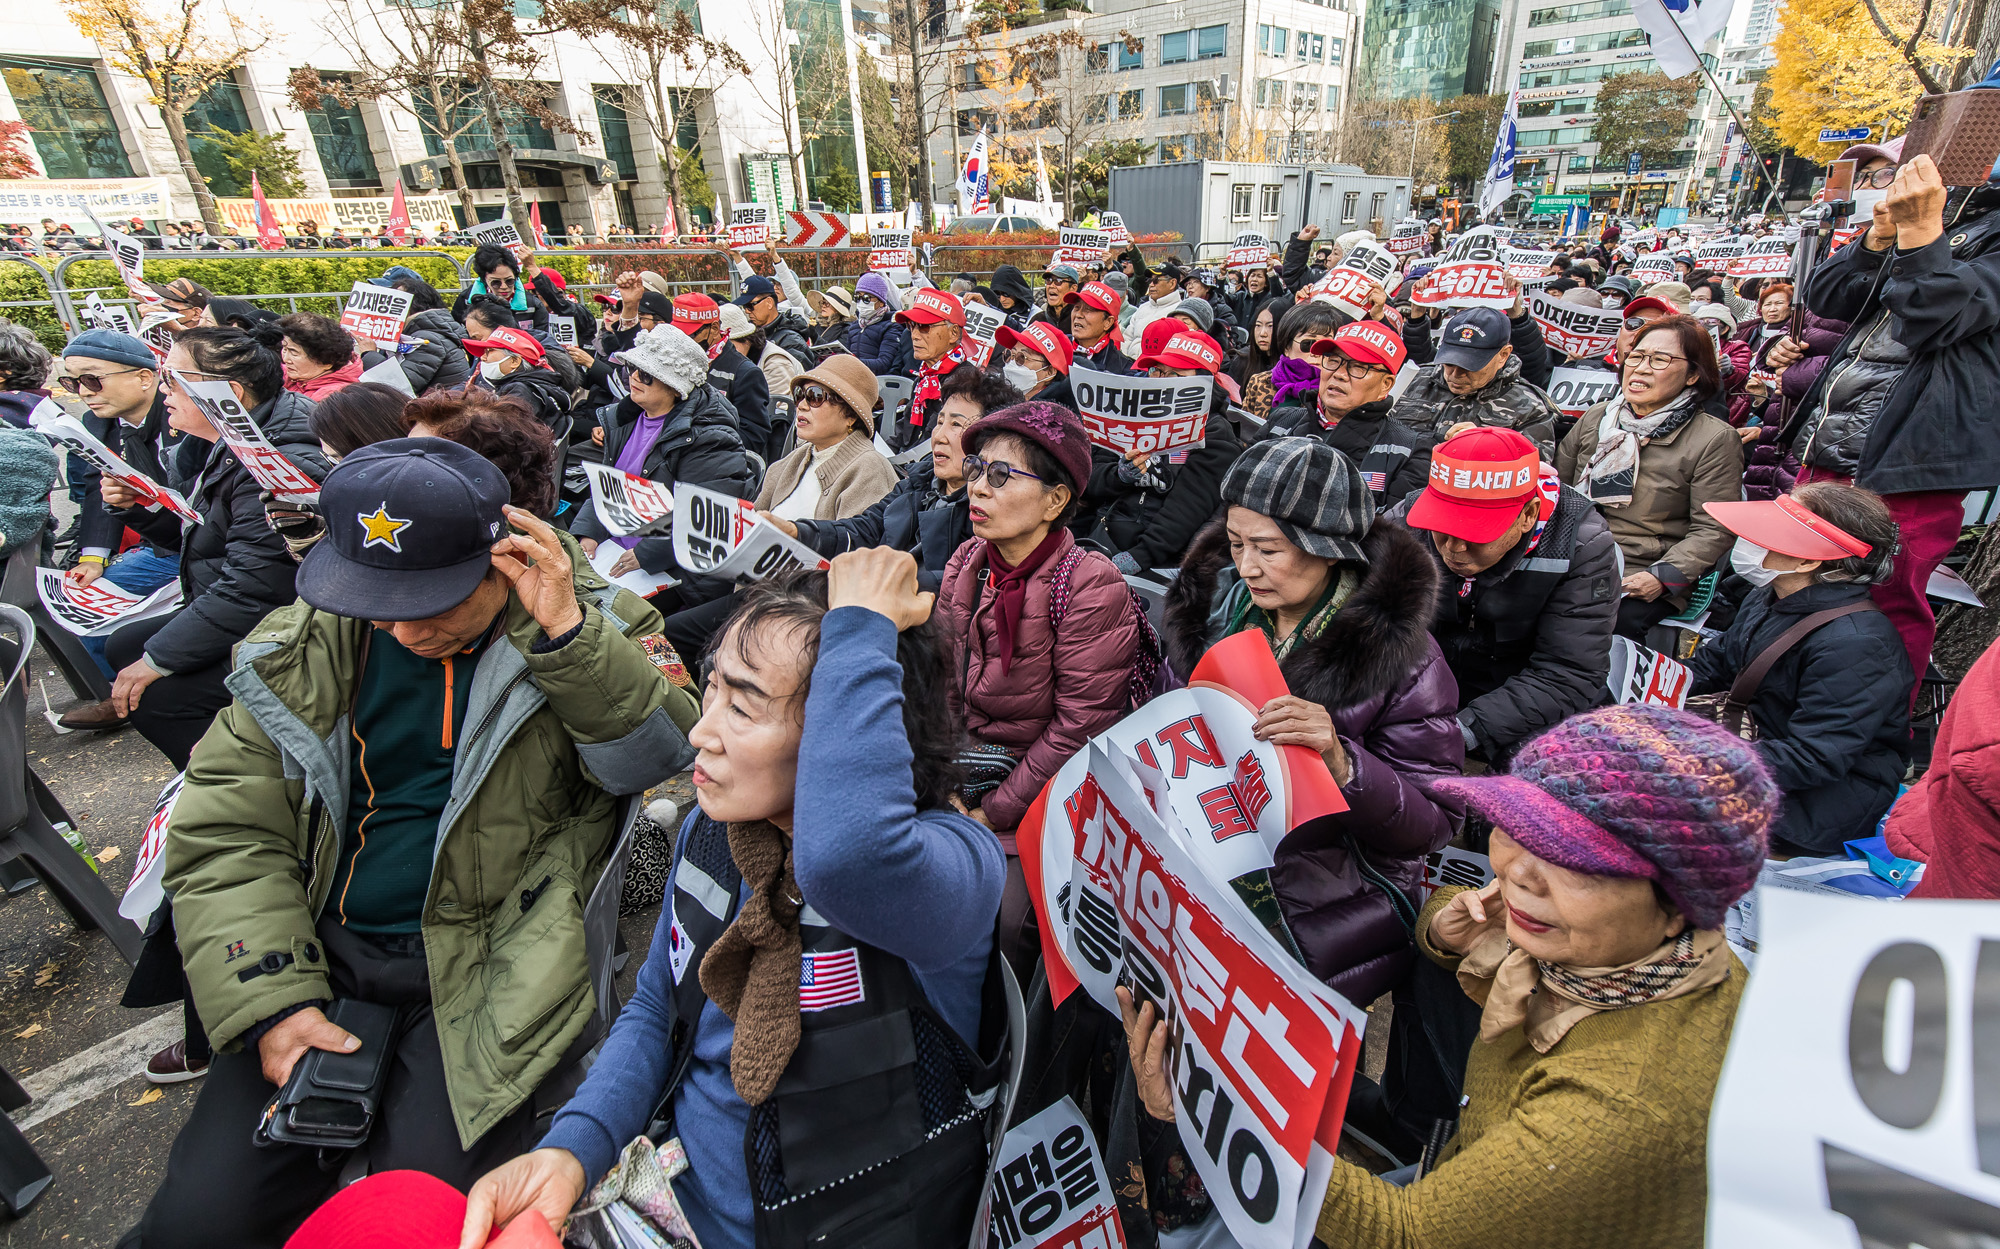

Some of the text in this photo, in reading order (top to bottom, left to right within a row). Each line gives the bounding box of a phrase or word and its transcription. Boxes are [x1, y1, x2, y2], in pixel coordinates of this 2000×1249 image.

[334, 202, 390, 226] 민주당을
[405, 200, 453, 222] 혁하자!
[733, 208, 767, 225] 재명을
[872, 234, 910, 248] 이재명을
[1062, 233, 1109, 249] 이재명을
[1394, 227, 1423, 239] 재명을
[1698, 246, 1745, 258] 이재명을
[1695, 260, 1728, 271] 구속하
[348, 290, 407, 316] 이재명을
[341, 313, 401, 340] 구속하라
[964, 309, 999, 340] 명을
[1533, 299, 1623, 335] 이재명을
[1027, 324, 1047, 341] 사대
[1347, 325, 1387, 348] 결사대
[1169, 337, 1203, 355] 결사대
[1076, 382, 1206, 418] 이재명을
[1082, 415, 1206, 455] 구속하라
[1454, 468, 1513, 490] 결사대
